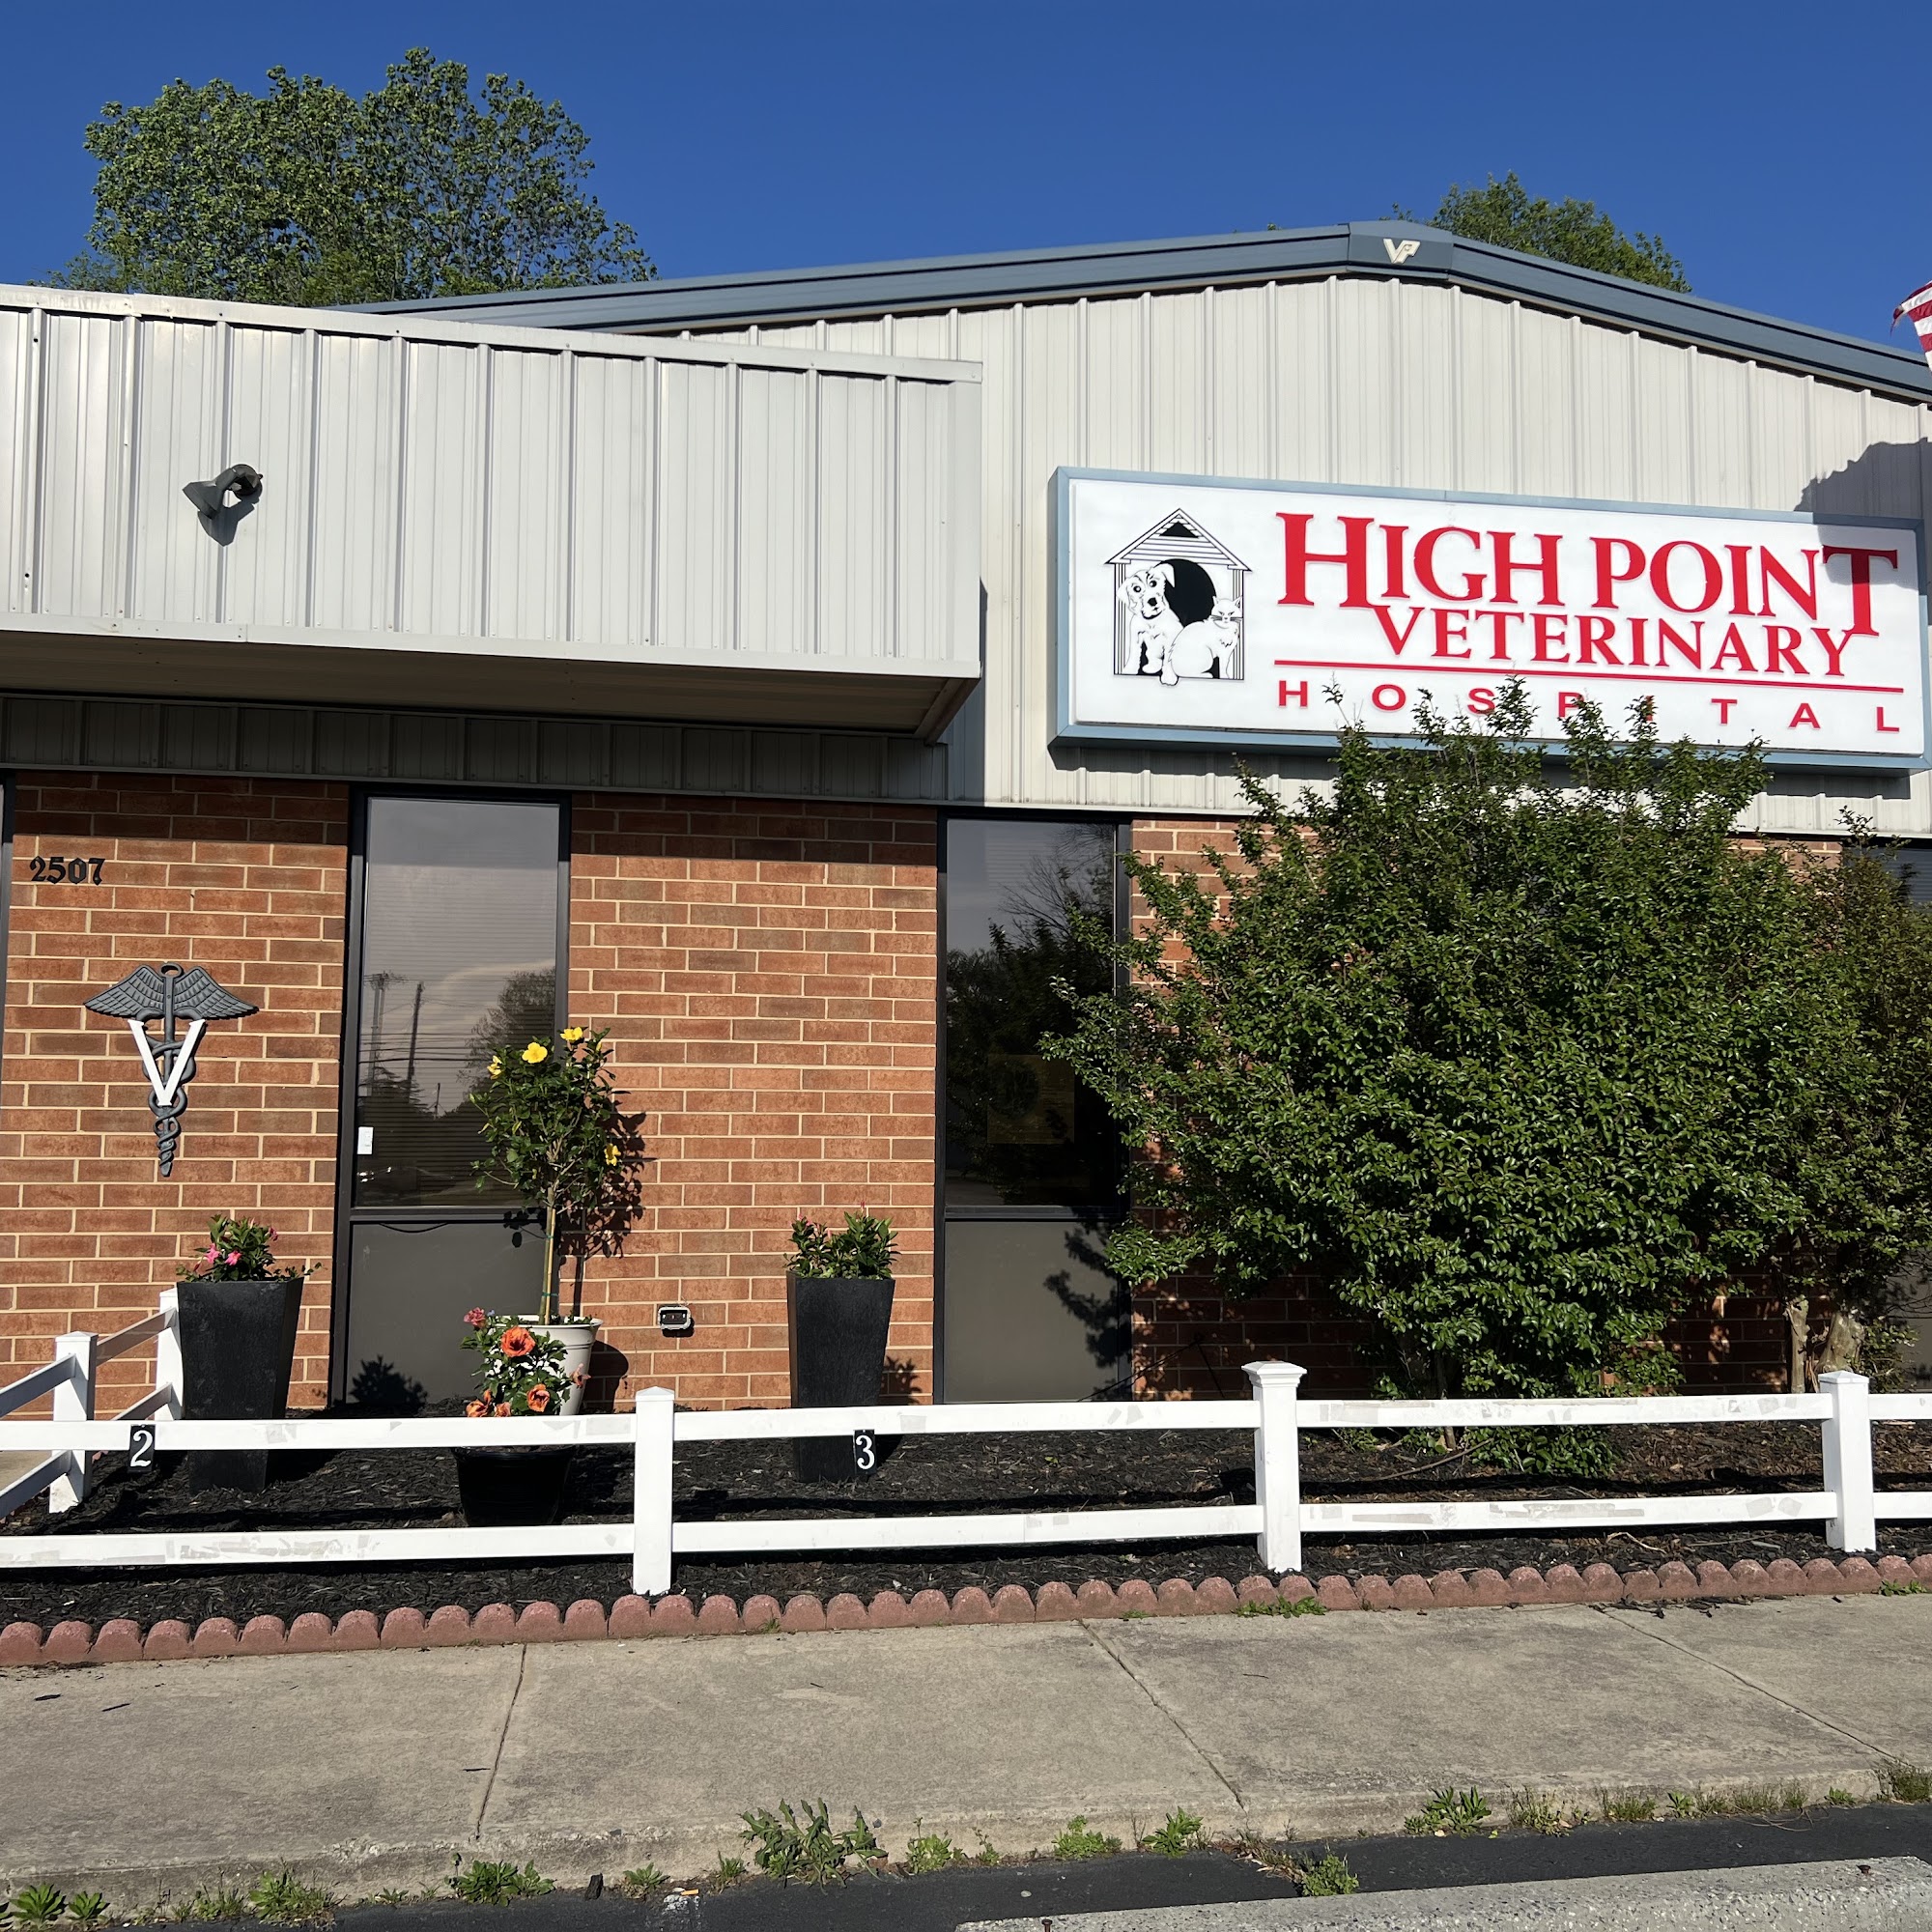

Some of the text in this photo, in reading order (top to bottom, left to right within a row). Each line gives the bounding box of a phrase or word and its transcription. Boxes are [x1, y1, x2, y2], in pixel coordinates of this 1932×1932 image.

[1276, 512, 1899, 637] HIGH POINT
[1372, 605, 1854, 677] VETERINARY
[29, 855, 106, 886] 2507
[128, 1019, 206, 1105] V
[129, 1430, 153, 1466] 2
[855, 1435, 875, 1469] 3
